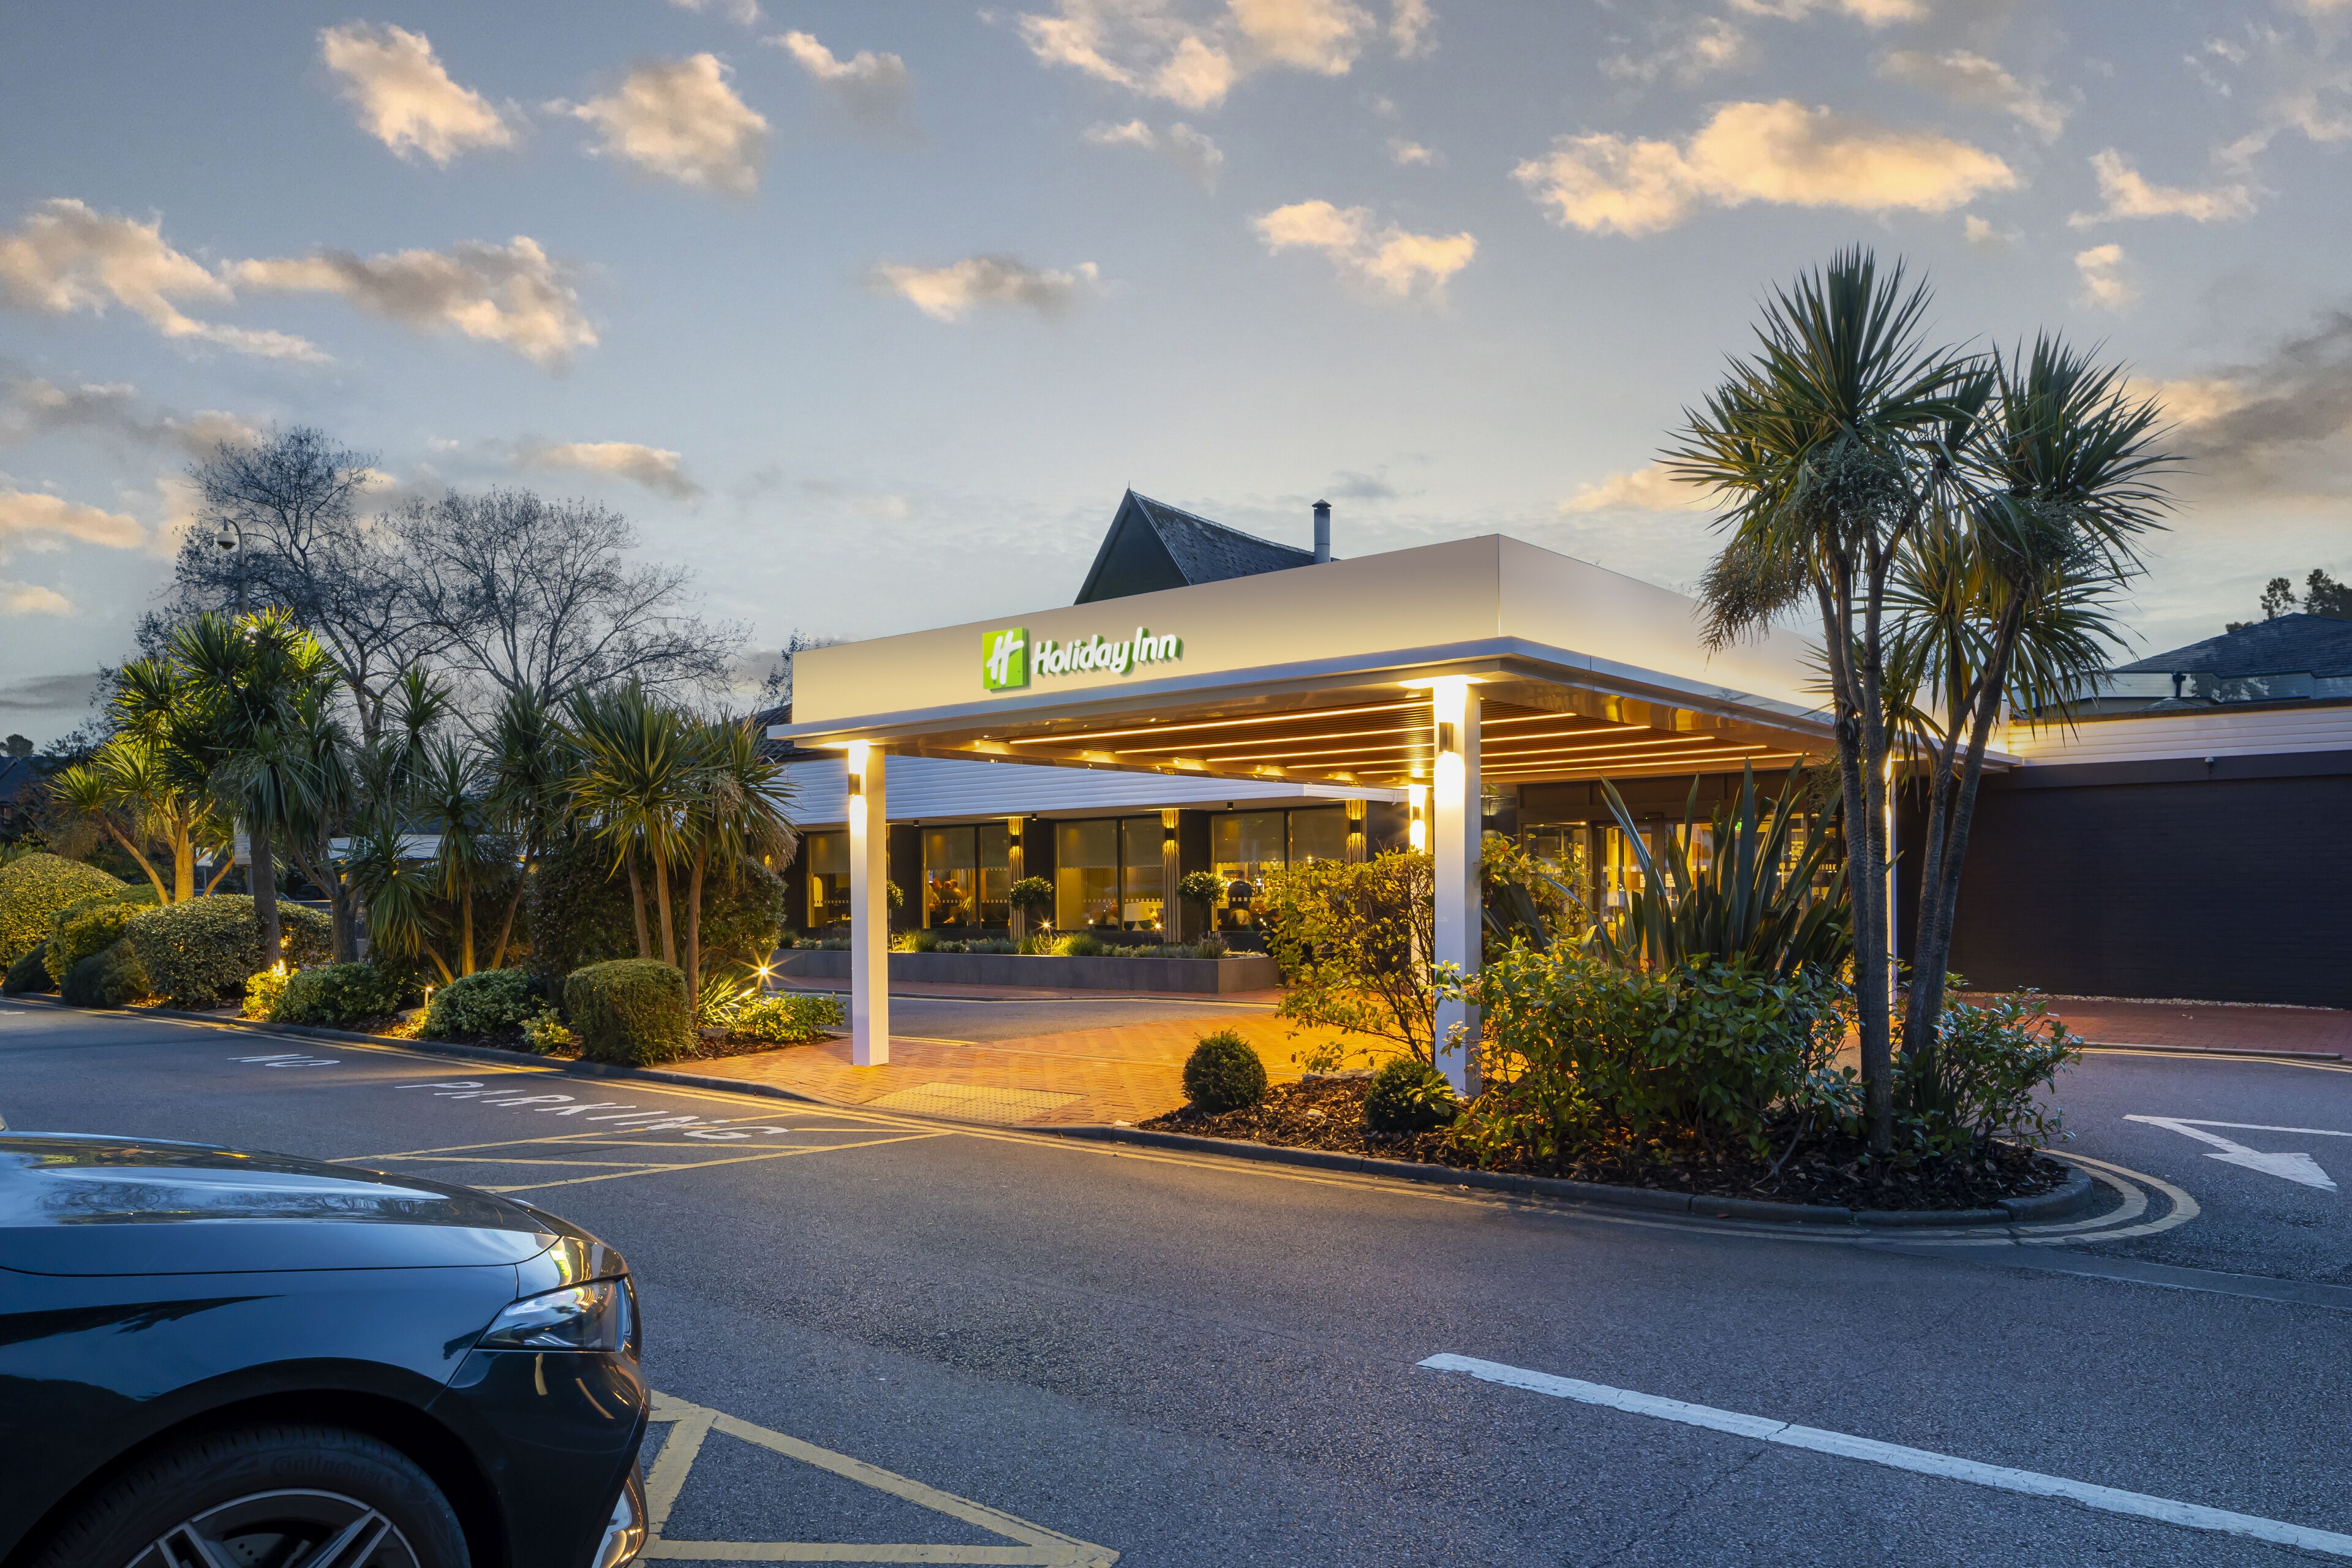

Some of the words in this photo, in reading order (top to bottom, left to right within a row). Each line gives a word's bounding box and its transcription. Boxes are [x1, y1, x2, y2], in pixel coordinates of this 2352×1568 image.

[1031, 634, 1133, 673] Holiday
[1133, 627, 1177, 662] Inn
[227, 1054, 341, 1068] NO
[394, 1081, 789, 1139] PARKING
